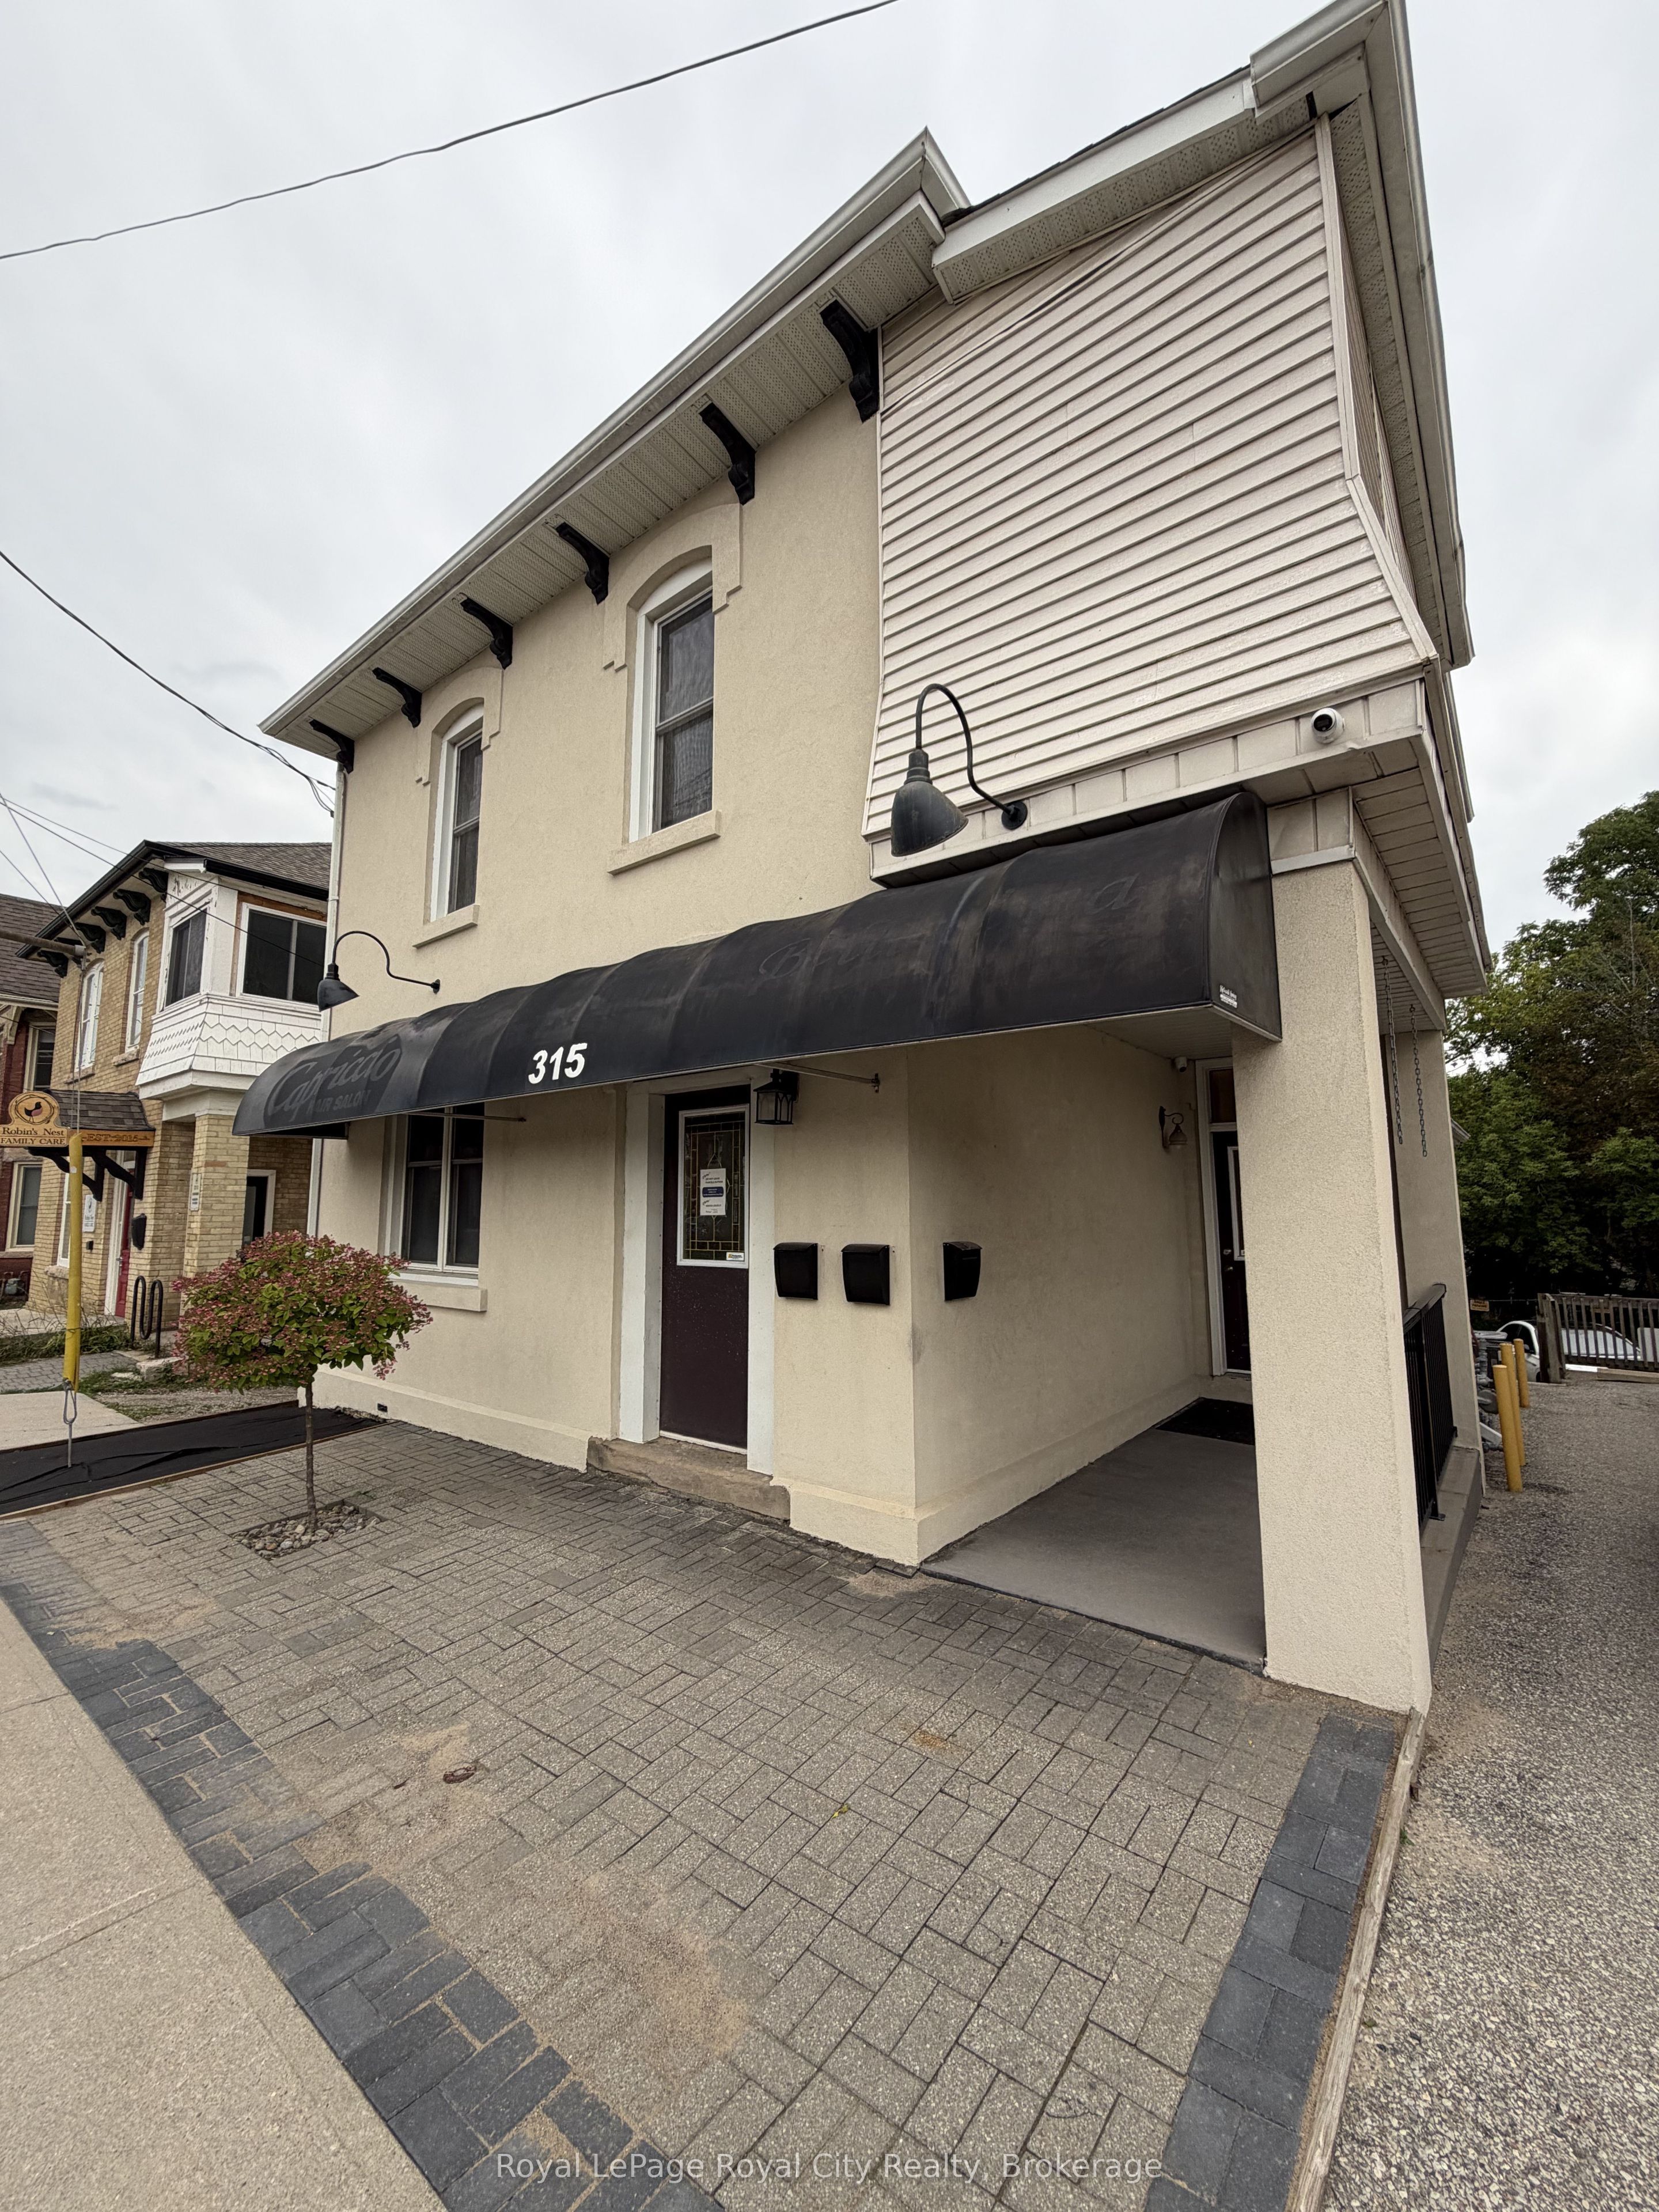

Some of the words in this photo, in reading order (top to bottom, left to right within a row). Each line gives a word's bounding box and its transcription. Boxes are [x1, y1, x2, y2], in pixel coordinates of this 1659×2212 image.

[528, 1043, 588, 1084] 315
[2, 1127, 37, 1135] Robin's
[43, 1128, 65, 1136] Nest
